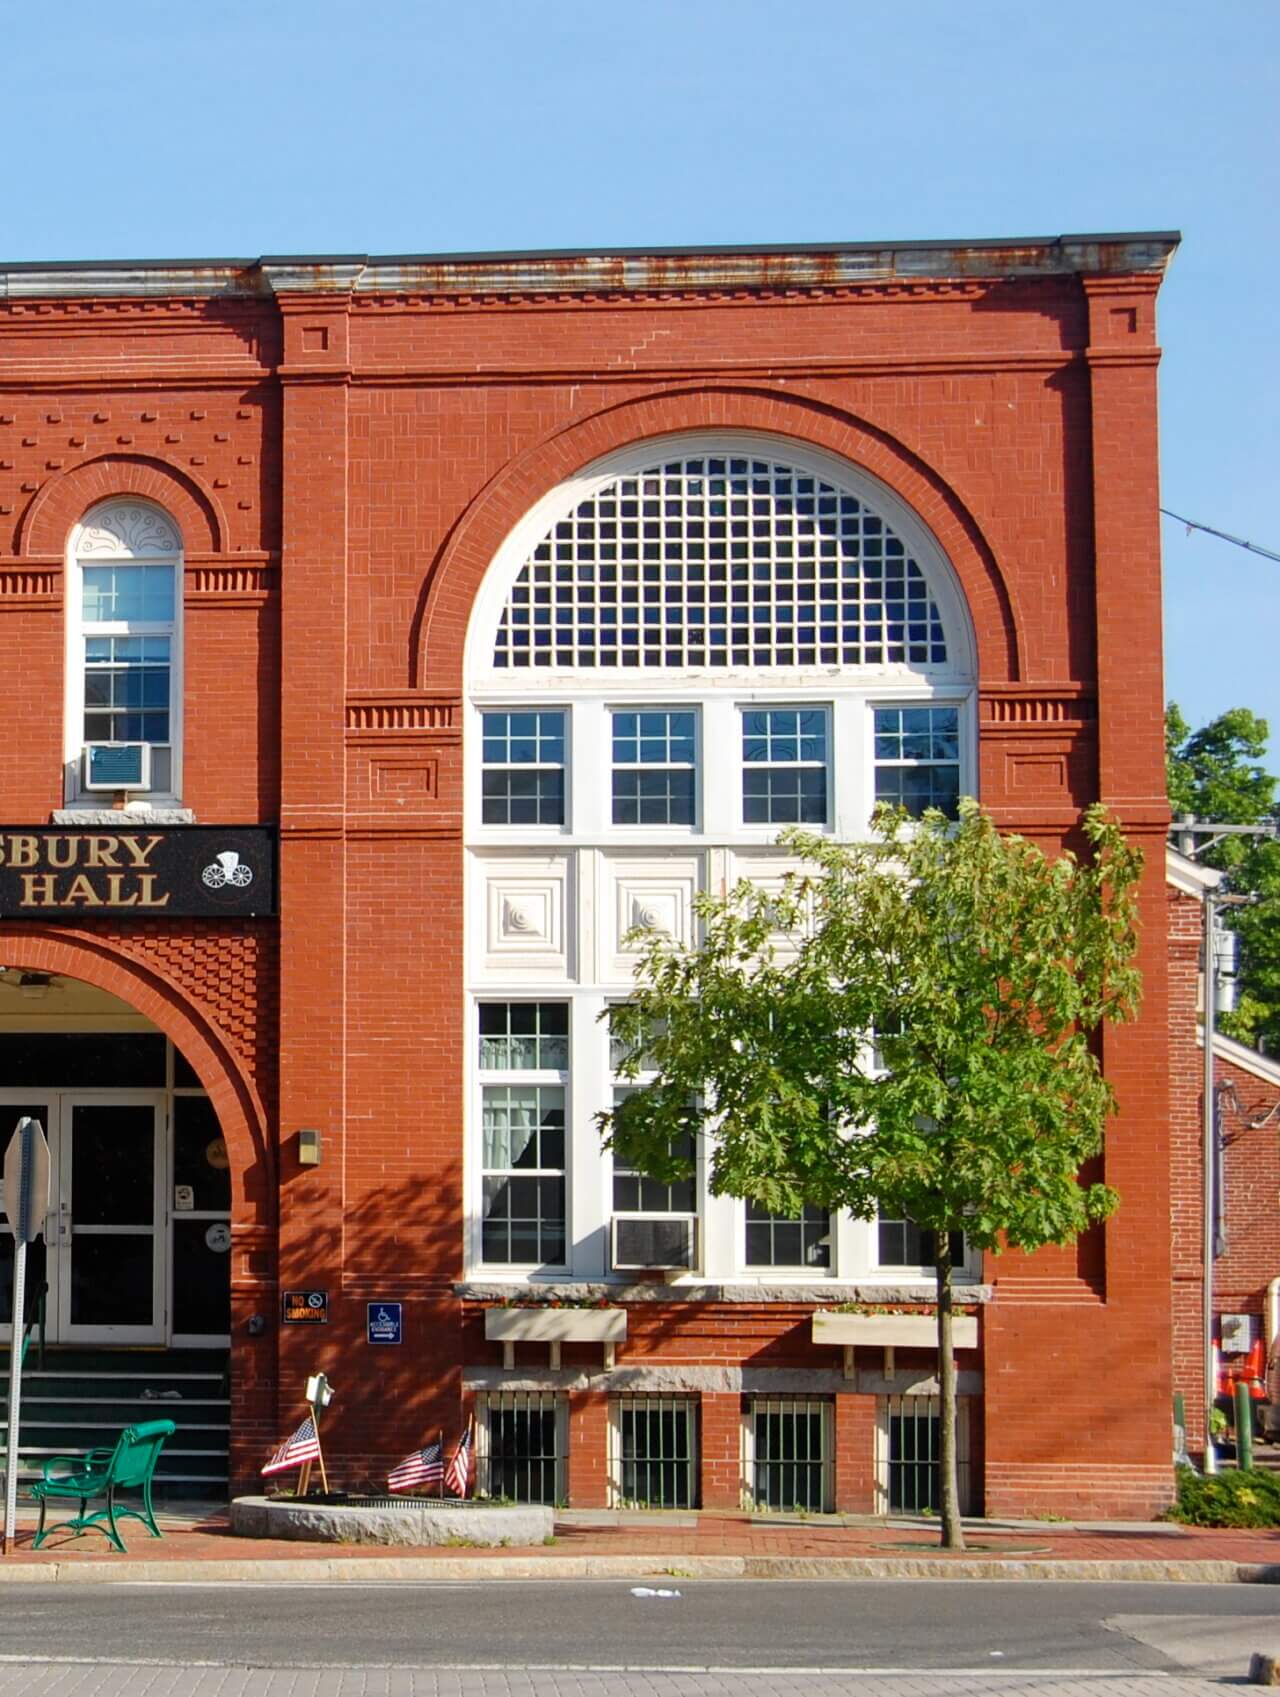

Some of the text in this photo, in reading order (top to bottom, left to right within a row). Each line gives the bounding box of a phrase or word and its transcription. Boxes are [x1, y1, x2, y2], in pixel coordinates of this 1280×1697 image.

[20, 873, 170, 907] HALL
[292, 1296, 305, 1307] NO
[287, 1308, 326, 1319] SMOKING
